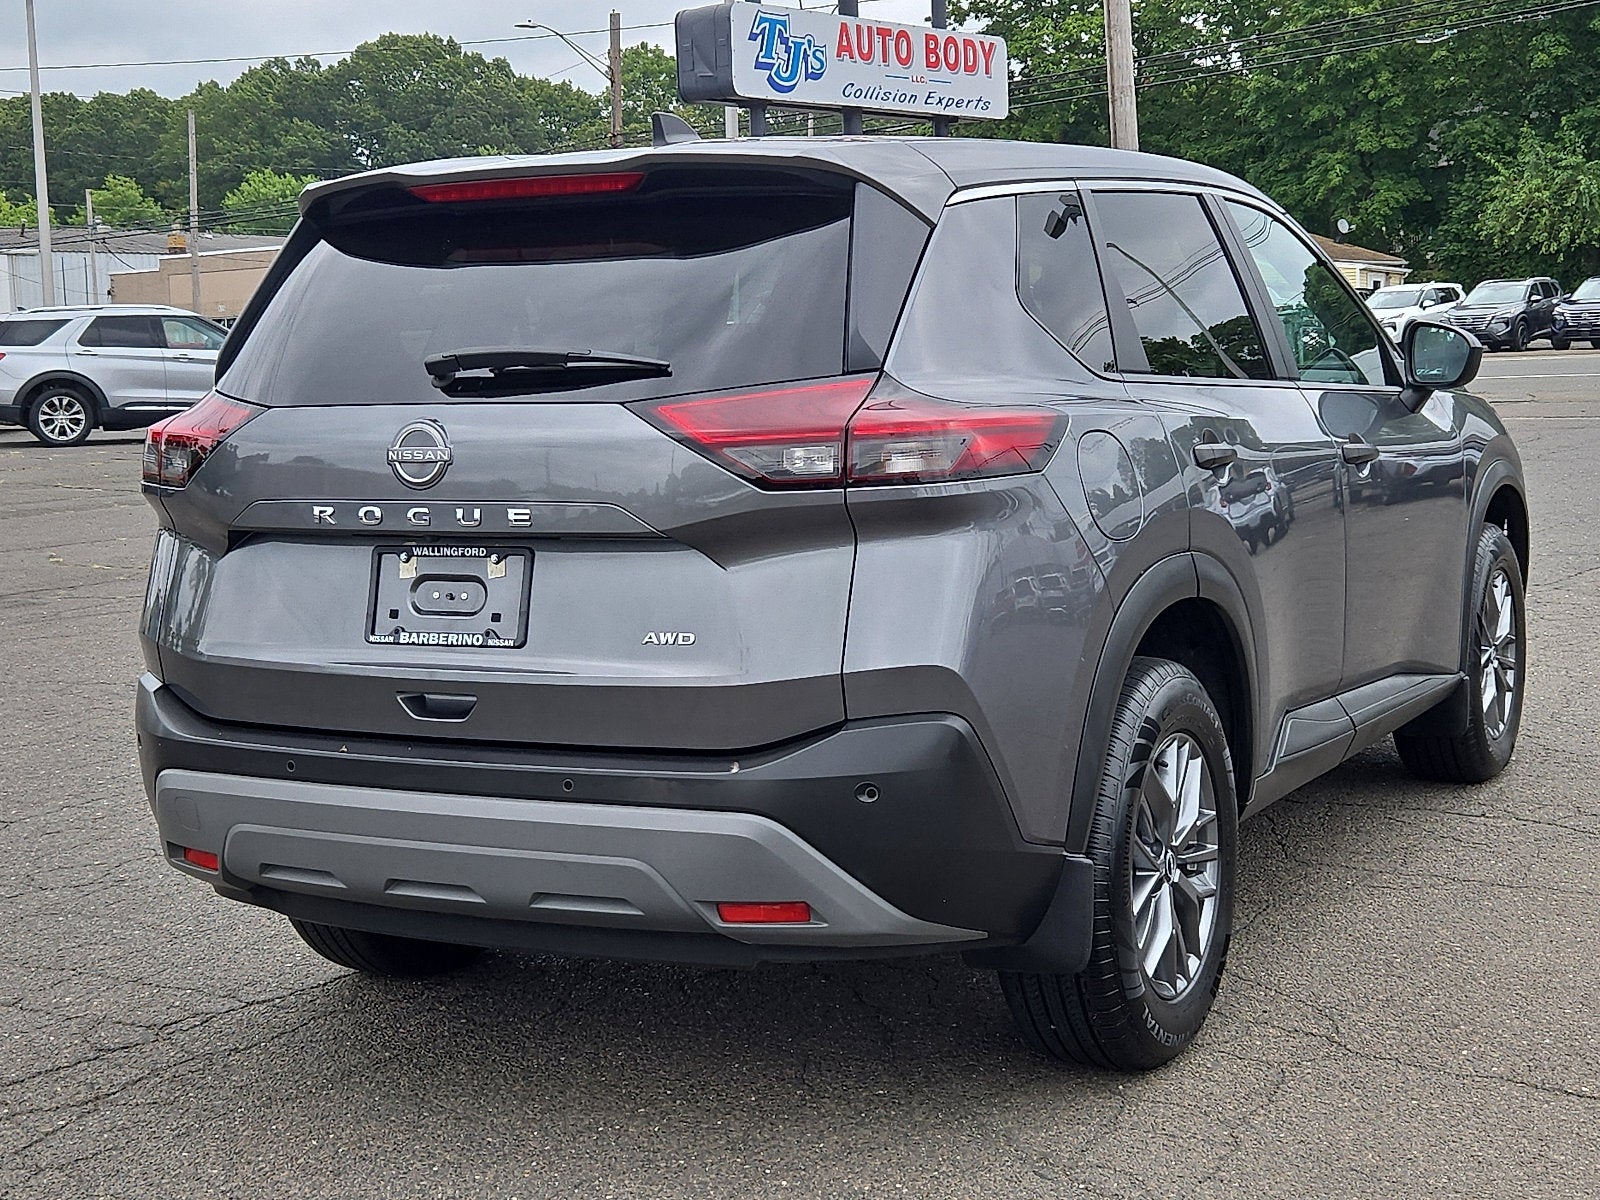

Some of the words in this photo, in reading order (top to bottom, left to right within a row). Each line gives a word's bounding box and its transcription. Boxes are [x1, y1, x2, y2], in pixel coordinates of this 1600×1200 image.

[836, 22, 914, 66] AUTO
[924, 33, 997, 77] BODY
[842, 83, 917, 104] Collision
[925, 92, 991, 111] Experts
[388, 450, 450, 461] NISSAN
[312, 505, 533, 528] ROGUE
[412, 547, 487, 557] WALLINGFORD
[369, 634, 394, 643] NISSAN
[400, 632, 483, 646] BARBERINO
[487, 638, 514, 647] NISSAN
[641, 631, 696, 646] AWD
